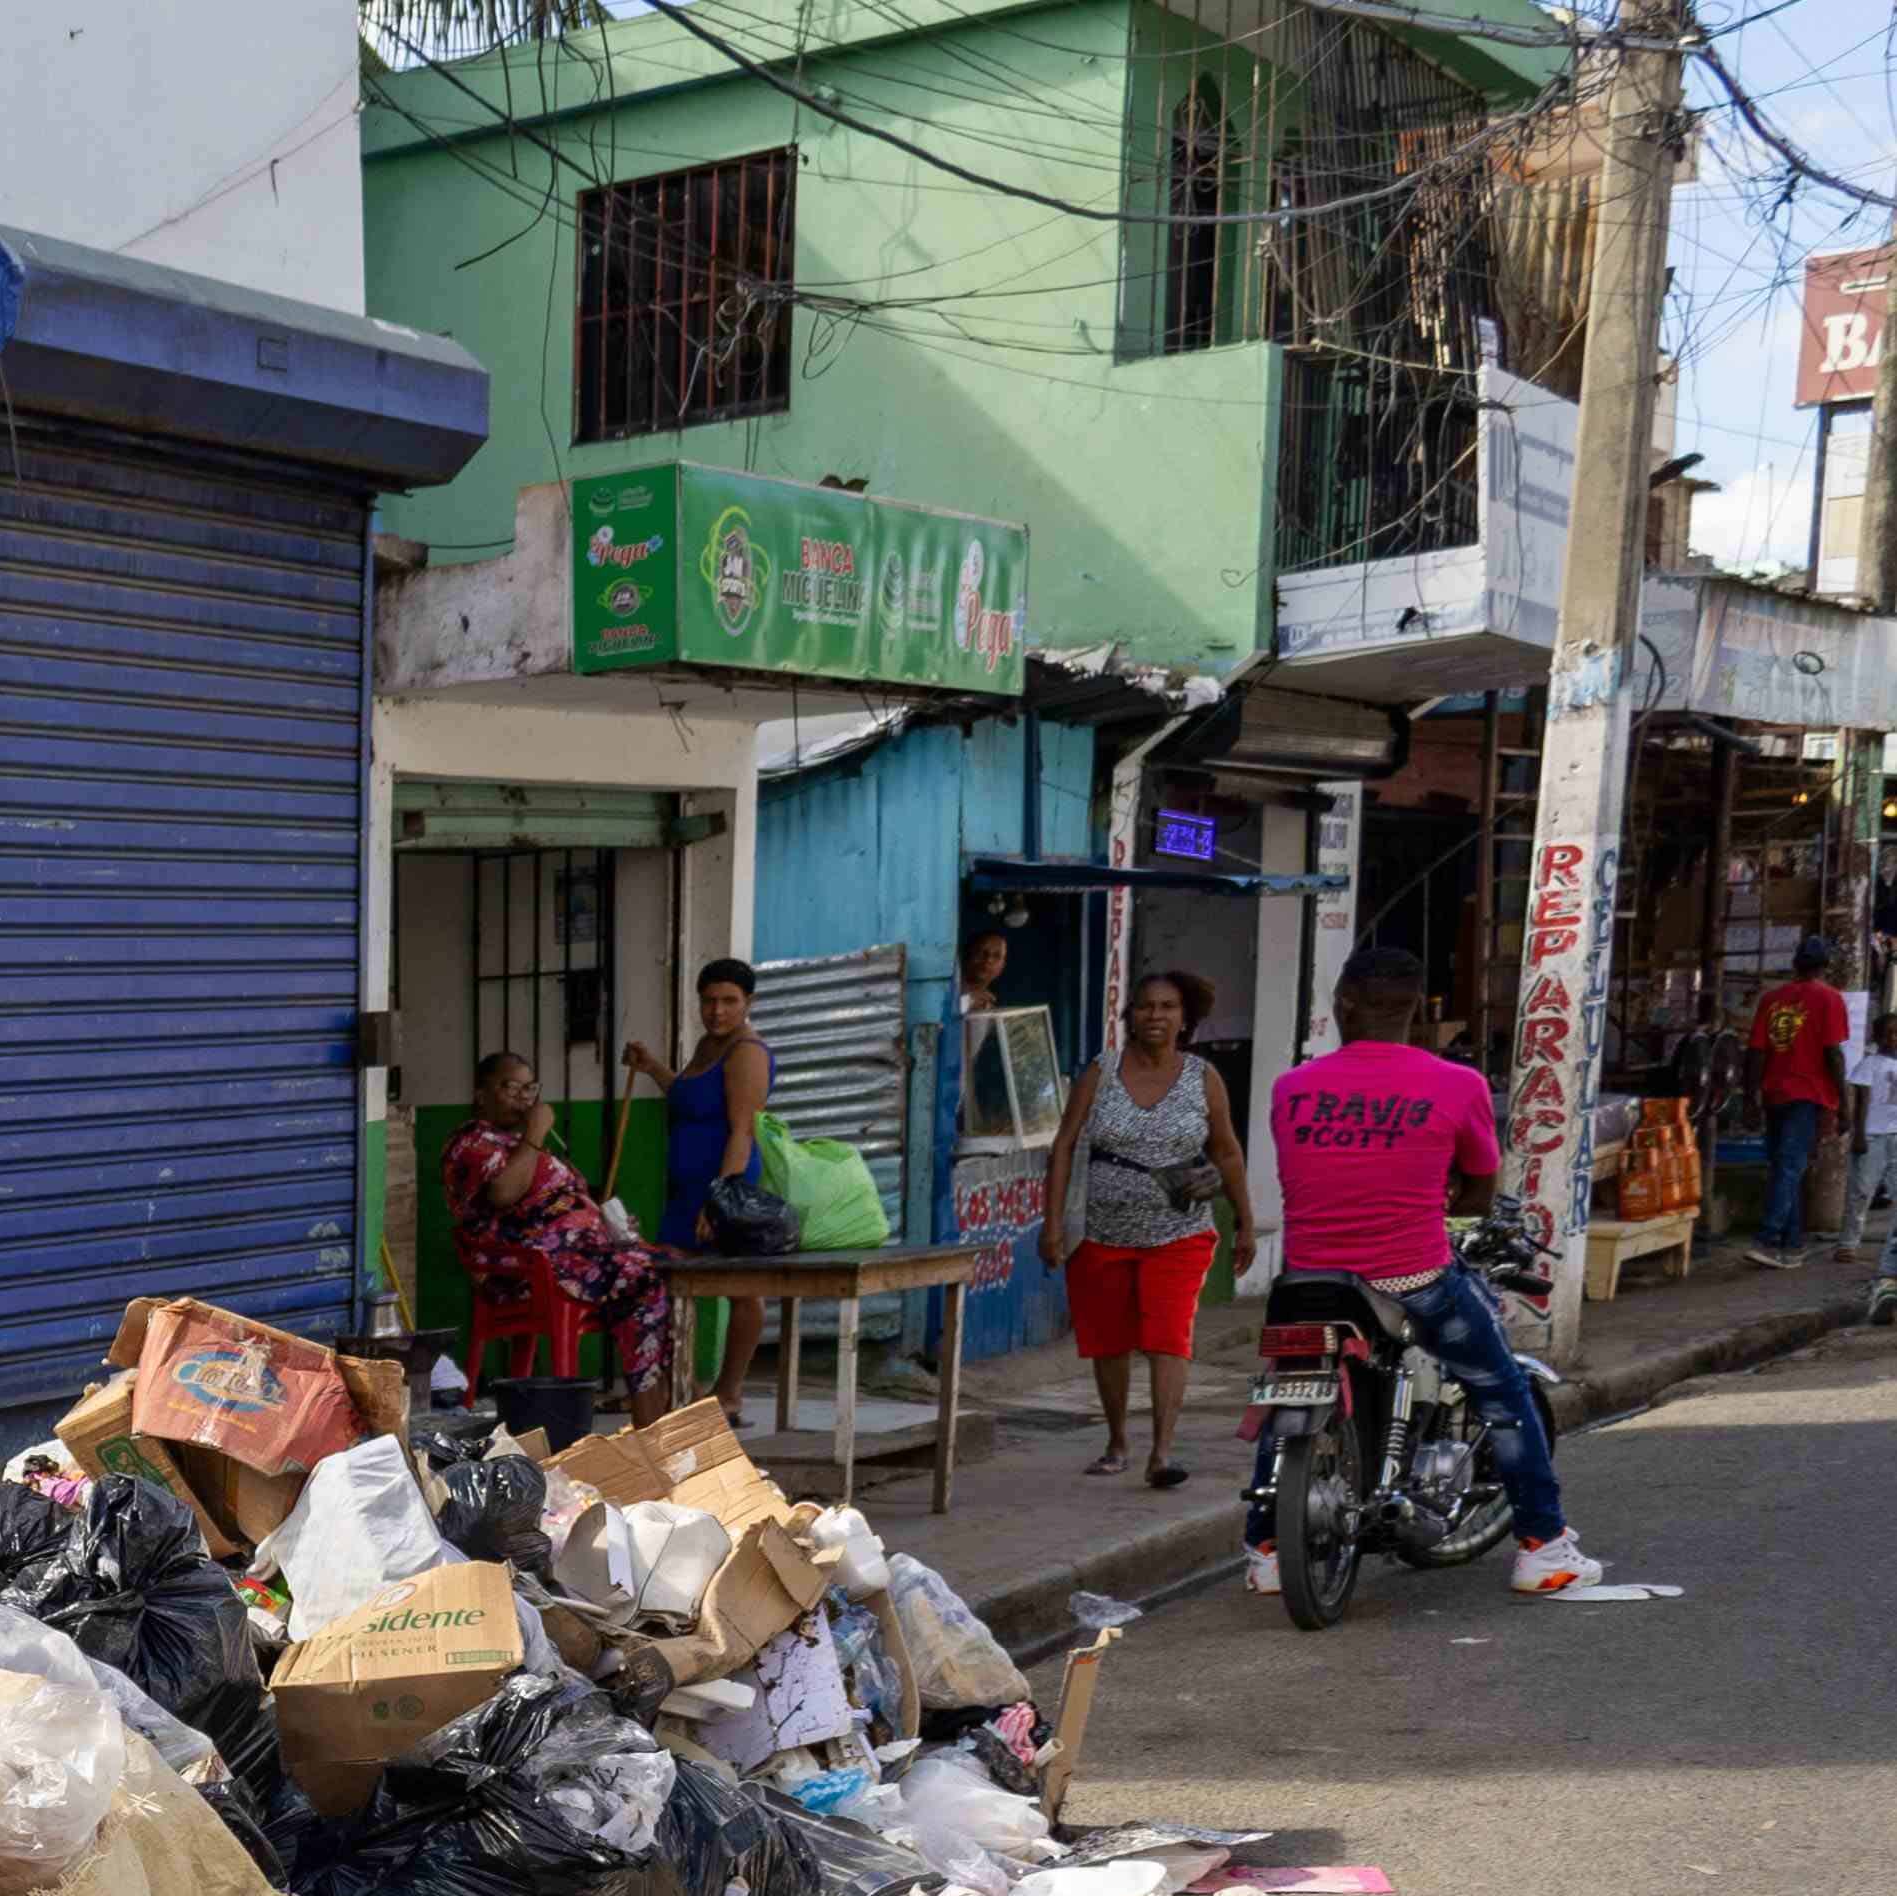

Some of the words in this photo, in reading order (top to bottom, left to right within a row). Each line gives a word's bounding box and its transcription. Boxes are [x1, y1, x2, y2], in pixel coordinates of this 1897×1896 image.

[801, 537, 854, 576] BANCA
[782, 570, 865, 614] MIGUELIN
[1288, 1089, 1433, 1127] TRAVIS
[1295, 1125, 1405, 1149] SCOTT
